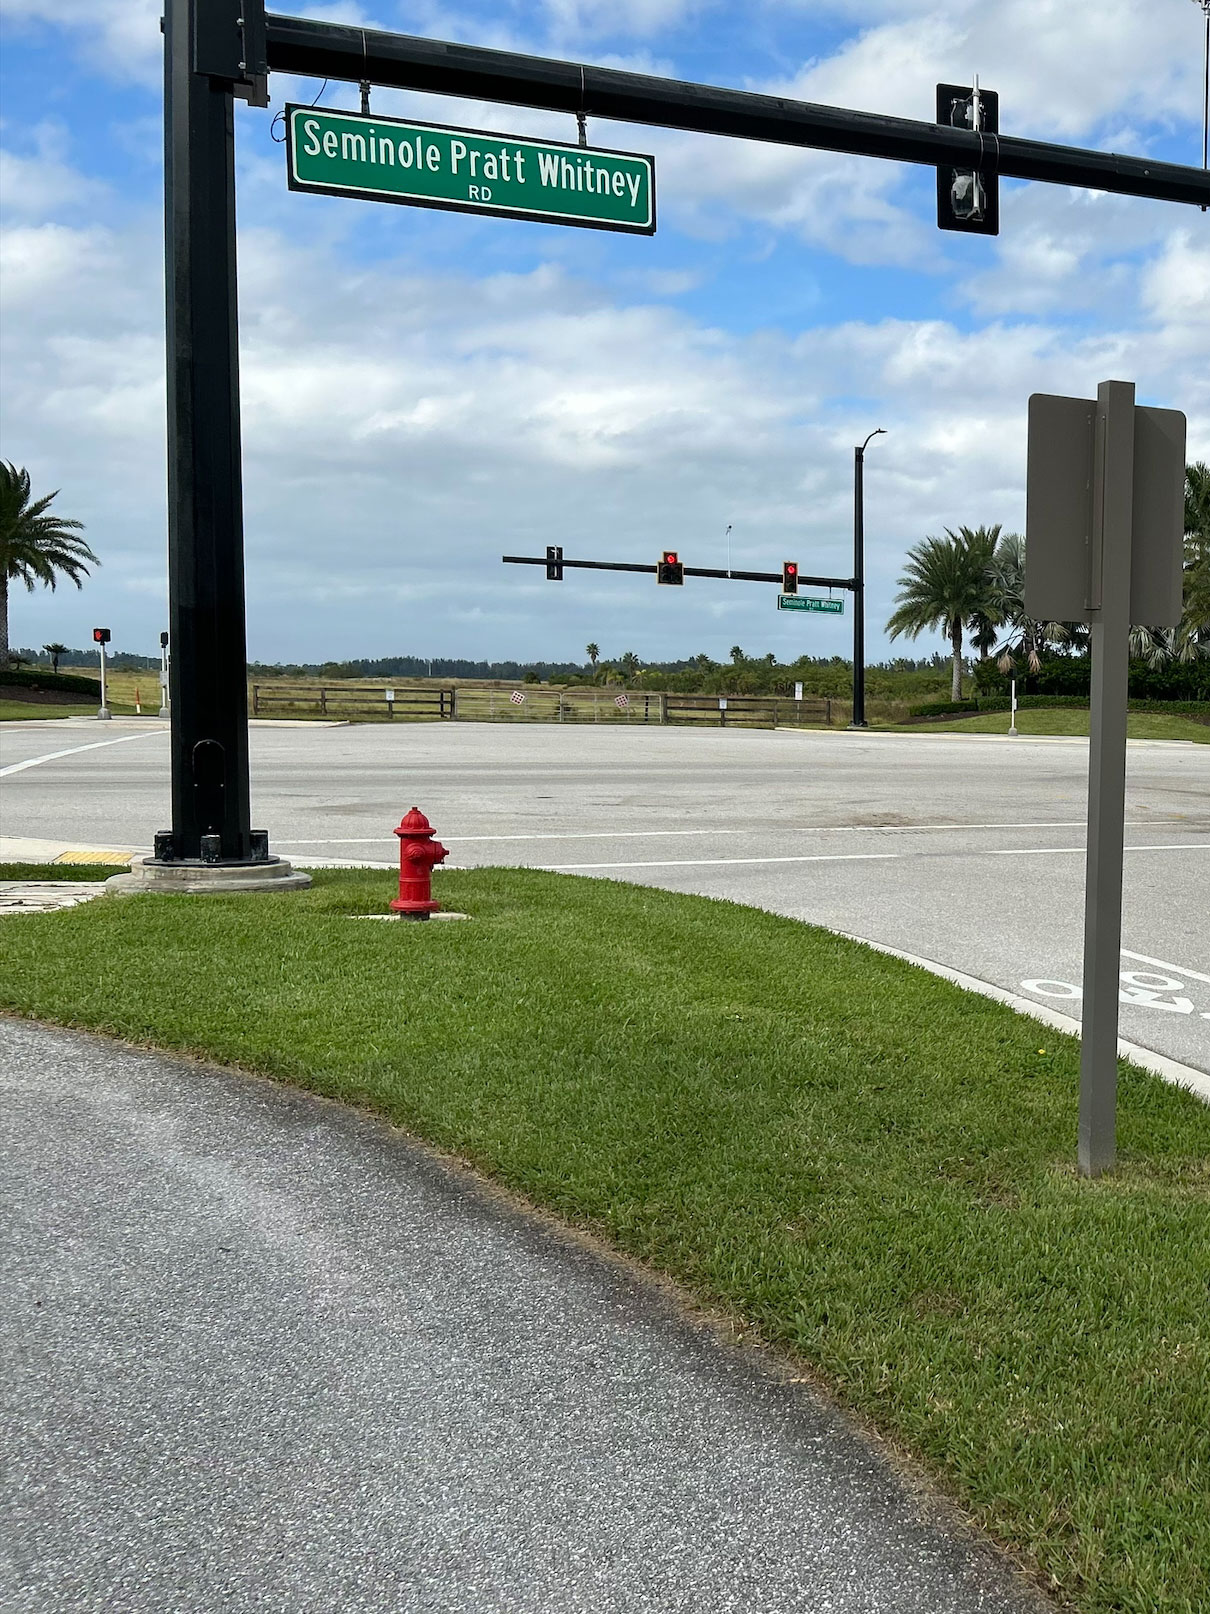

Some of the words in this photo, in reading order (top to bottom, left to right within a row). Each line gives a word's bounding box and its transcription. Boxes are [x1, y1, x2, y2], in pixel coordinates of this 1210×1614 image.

[302, 119, 441, 172] Seminole
[450, 139, 526, 184] Pratt
[537, 151, 642, 207] Whitney
[468, 185, 492, 202] RD
[783, 598, 805, 607] Seminole
[806, 599, 820, 608] Pratt
[821, 601, 840, 611] Whitney
